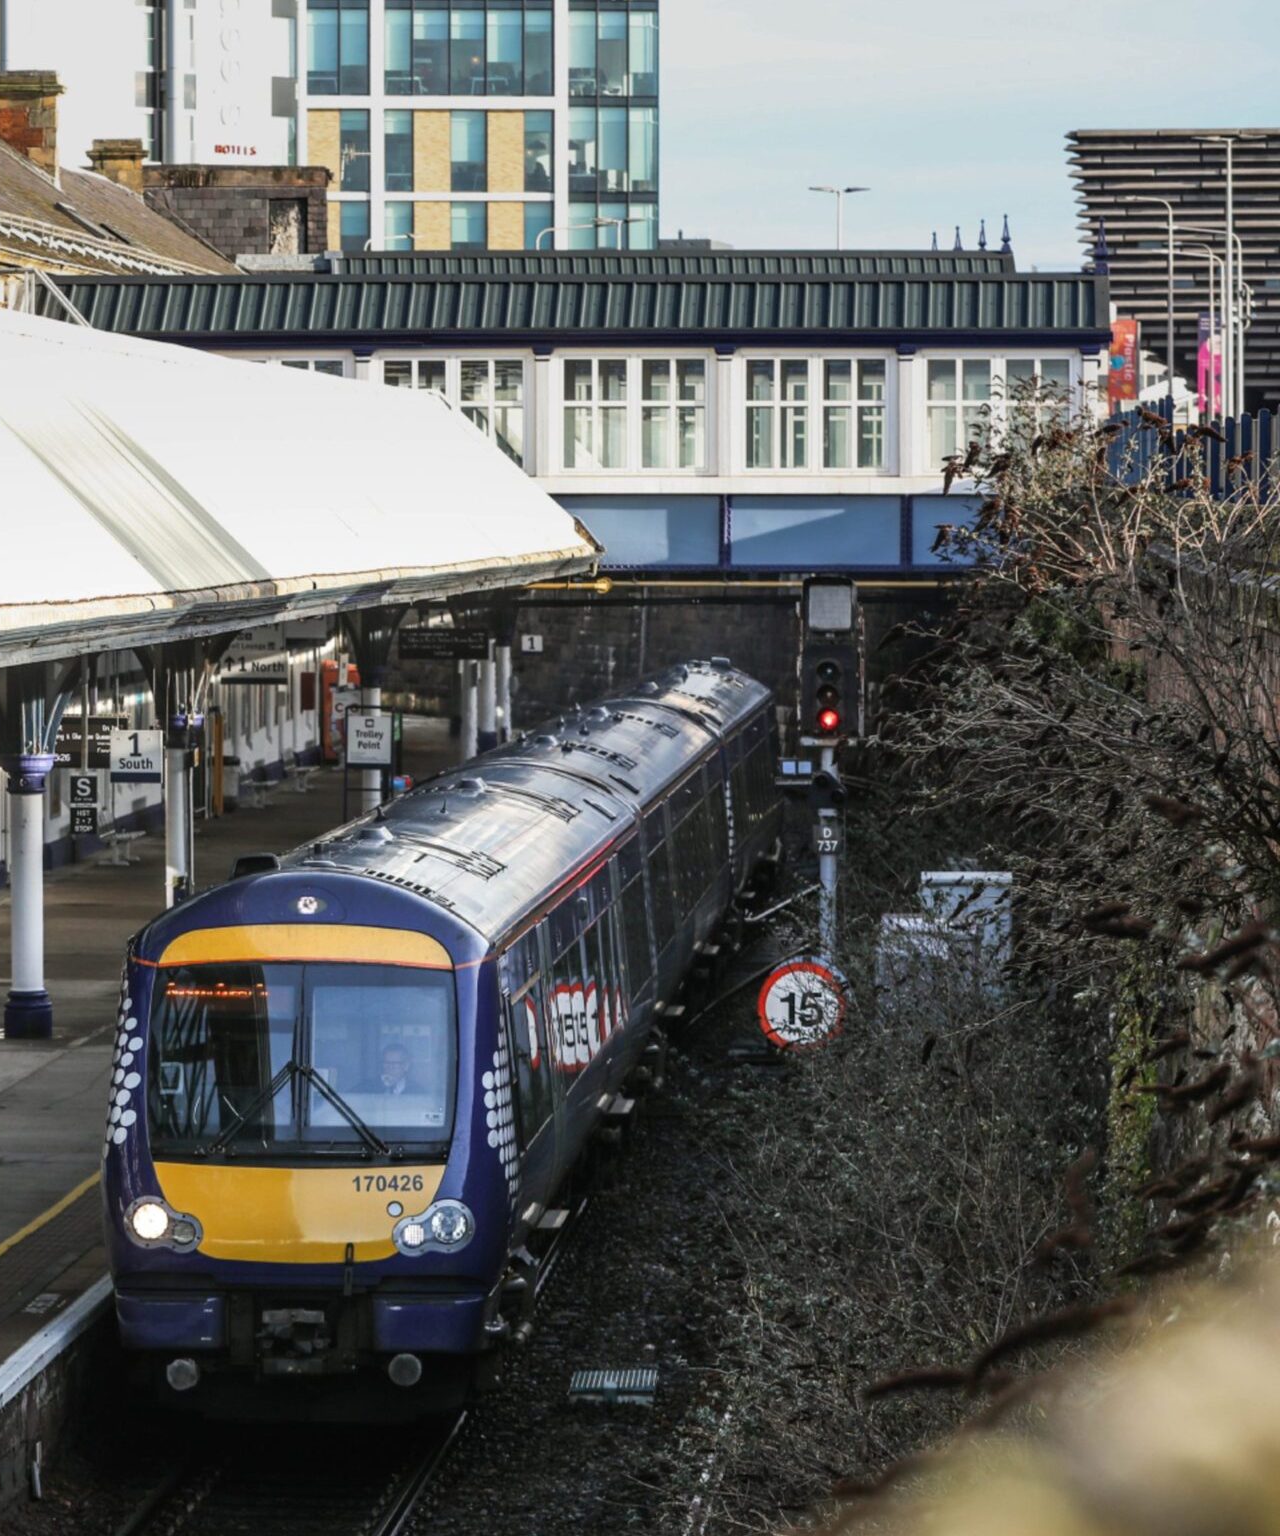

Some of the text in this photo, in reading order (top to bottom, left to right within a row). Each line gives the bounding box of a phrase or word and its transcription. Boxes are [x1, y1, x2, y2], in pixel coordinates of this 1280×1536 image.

[527, 636, 535, 650] 1
[238, 656, 285, 673] 1 North
[355, 729, 384, 741] Trolley
[128, 732, 142, 757] 1
[358, 740, 381, 750] Point
[119, 758, 153, 769] South
[76, 778, 91, 796] S
[823, 828, 832, 838] D
[816, 840, 838, 852] 737
[780, 990, 824, 1027] 15
[352, 1174, 424, 1193] 170426
